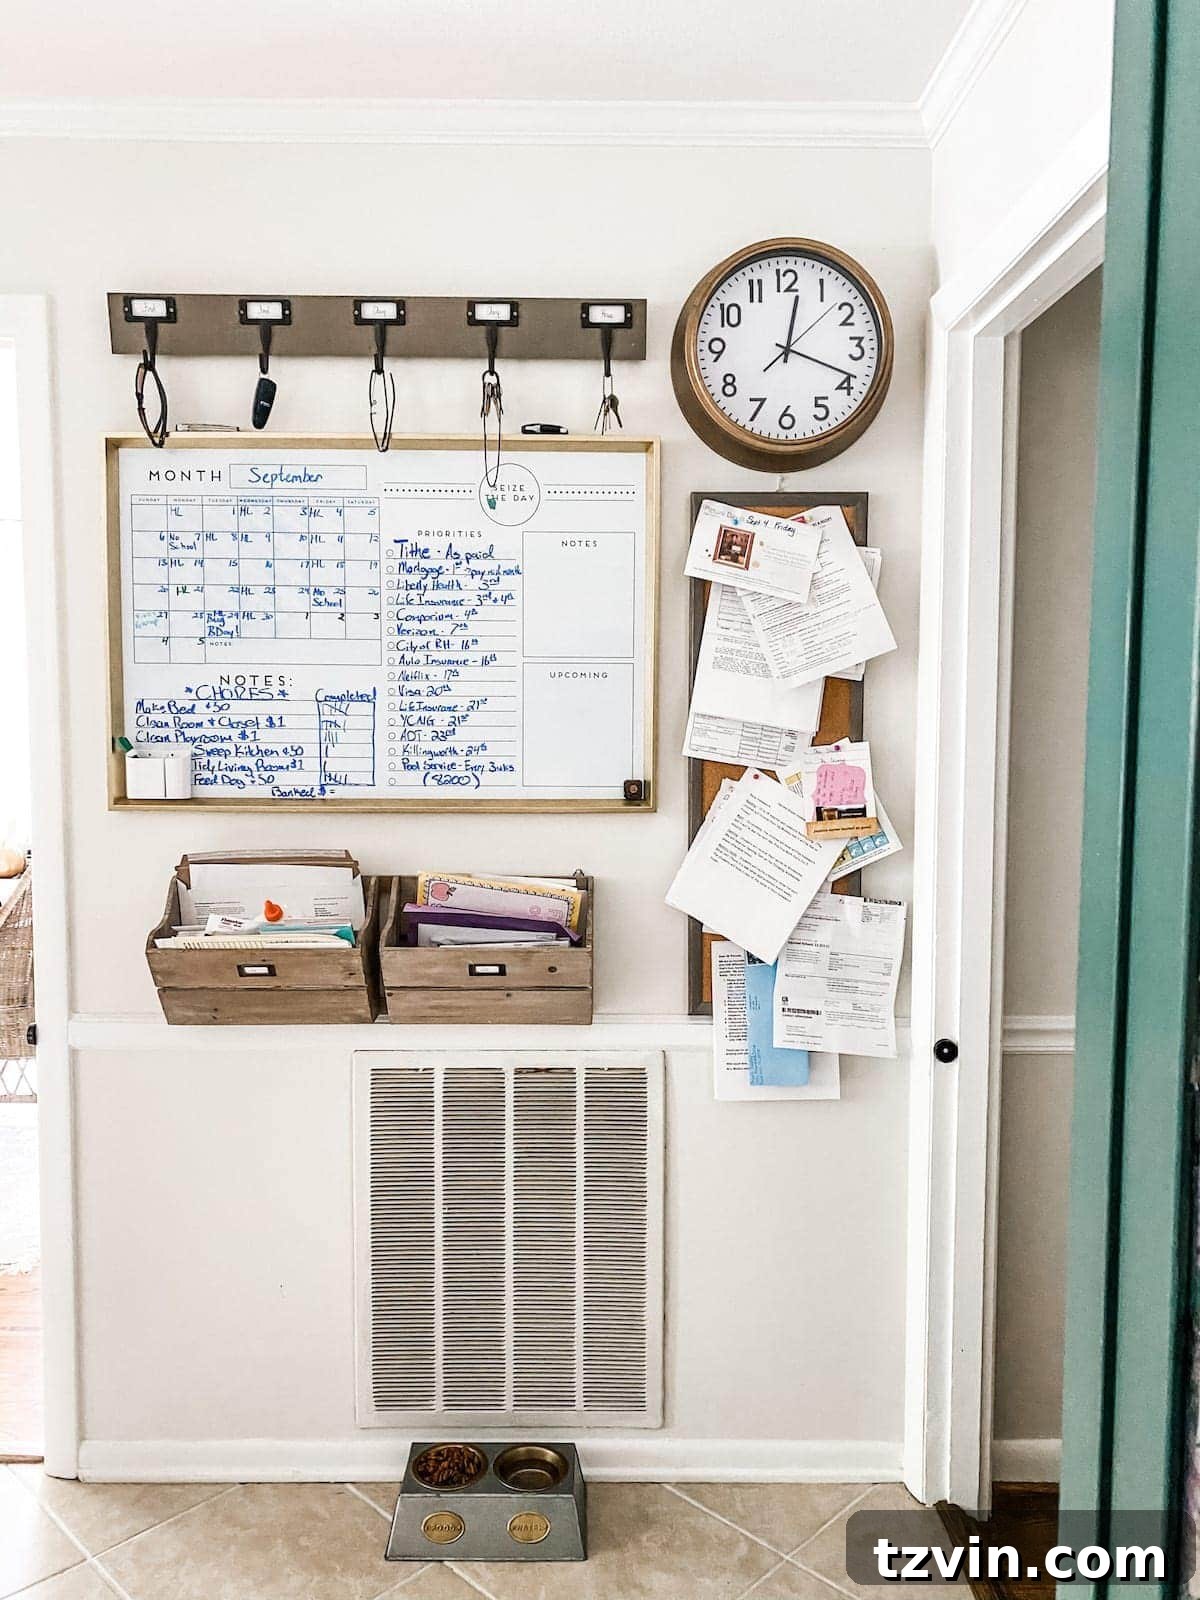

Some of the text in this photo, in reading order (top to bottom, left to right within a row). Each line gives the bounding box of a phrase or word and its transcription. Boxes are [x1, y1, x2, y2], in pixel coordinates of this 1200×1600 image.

[776, 268, 799, 293] 12
[748, 278, 762, 303] 11
[819, 278, 824, 302] 1
[720, 302, 742, 328] 10
[838, 302, 855, 326] 2
[708, 337, 726, 362] 9
[848, 336, 866, 361] 3
[722, 373, 737, 398] 8
[835, 374, 854, 396] 4
[749, 398, 768, 422] 7
[813, 396, 830, 421] 5
[778, 404, 796, 430] 6
[148, 470, 222, 482] MONTH
[248, 466, 323, 489] September
[493, 484, 525, 492] SEIZE
[486, 494, 534, 502] THE DAY
[170, 506, 184, 516] HL
[240, 506, 271, 516] HL 2
[310, 507, 342, 518] HL 4
[746, 515, 797, 538] Sept 4 Friday
[160, 532, 165, 541] 6
[206, 533, 218, 541] HL
[266, 532, 270, 542] 9
[299, 534, 308, 542] 10
[310, 534, 326, 544] HL
[370, 533, 379, 544] 12
[418, 530, 482, 538] PRIORITIES
[168, 541, 197, 550] School
[561, 540, 598, 548] NOTES
[446, 542, 461, 560] As
[465, 544, 494, 565] paid
[170, 558, 204, 568] HL 14
[311, 560, 326, 568] HL
[370, 560, 378, 570] 19
[240, 586, 254, 596] HL
[313, 588, 326, 596] No
[396, 579, 428, 595] Liberty
[432, 580, 462, 590] Health
[312, 598, 342, 608] School
[417, 593, 464, 606] Insurance
[476, 592, 492, 606] 3rd
[227, 612, 239, 620] 29
[242, 612, 256, 620] HL
[338, 613, 345, 621] 2
[373, 612, 380, 620] 3
[396, 622, 440, 636] Verizon
[162, 636, 168, 646] 4
[197, 636, 206, 646] 5
[396, 640, 417, 653] City
[420, 641, 430, 650] of
[398, 654, 420, 666] Auto
[424, 654, 470, 666] Insurance
[220, 674, 293, 686] NOTES:
[398, 670, 430, 682] Netflix
[196, 684, 274, 700] CHORES
[315, 686, 377, 703] Completed
[398, 684, 421, 696] Visa
[136, 698, 166, 714] Make
[168, 700, 196, 714] Bed
[416, 702, 458, 712] Insurance
[136, 715, 286, 729] Clean Room Closet $1
[136, 730, 260, 746] Clean Playroom $1
[194, 744, 231, 759] Sweep
[234, 744, 279, 756] Kitchen
[192, 758, 304, 778] Tidy Living Room $1
[401, 758, 420, 771] Pool
[424, 760, 457, 770] Service
[464, 760, 485, 774] Every
[194, 774, 218, 786] Feed
[221, 774, 246, 789] Dog
[272, 784, 326, 798] Banked $
